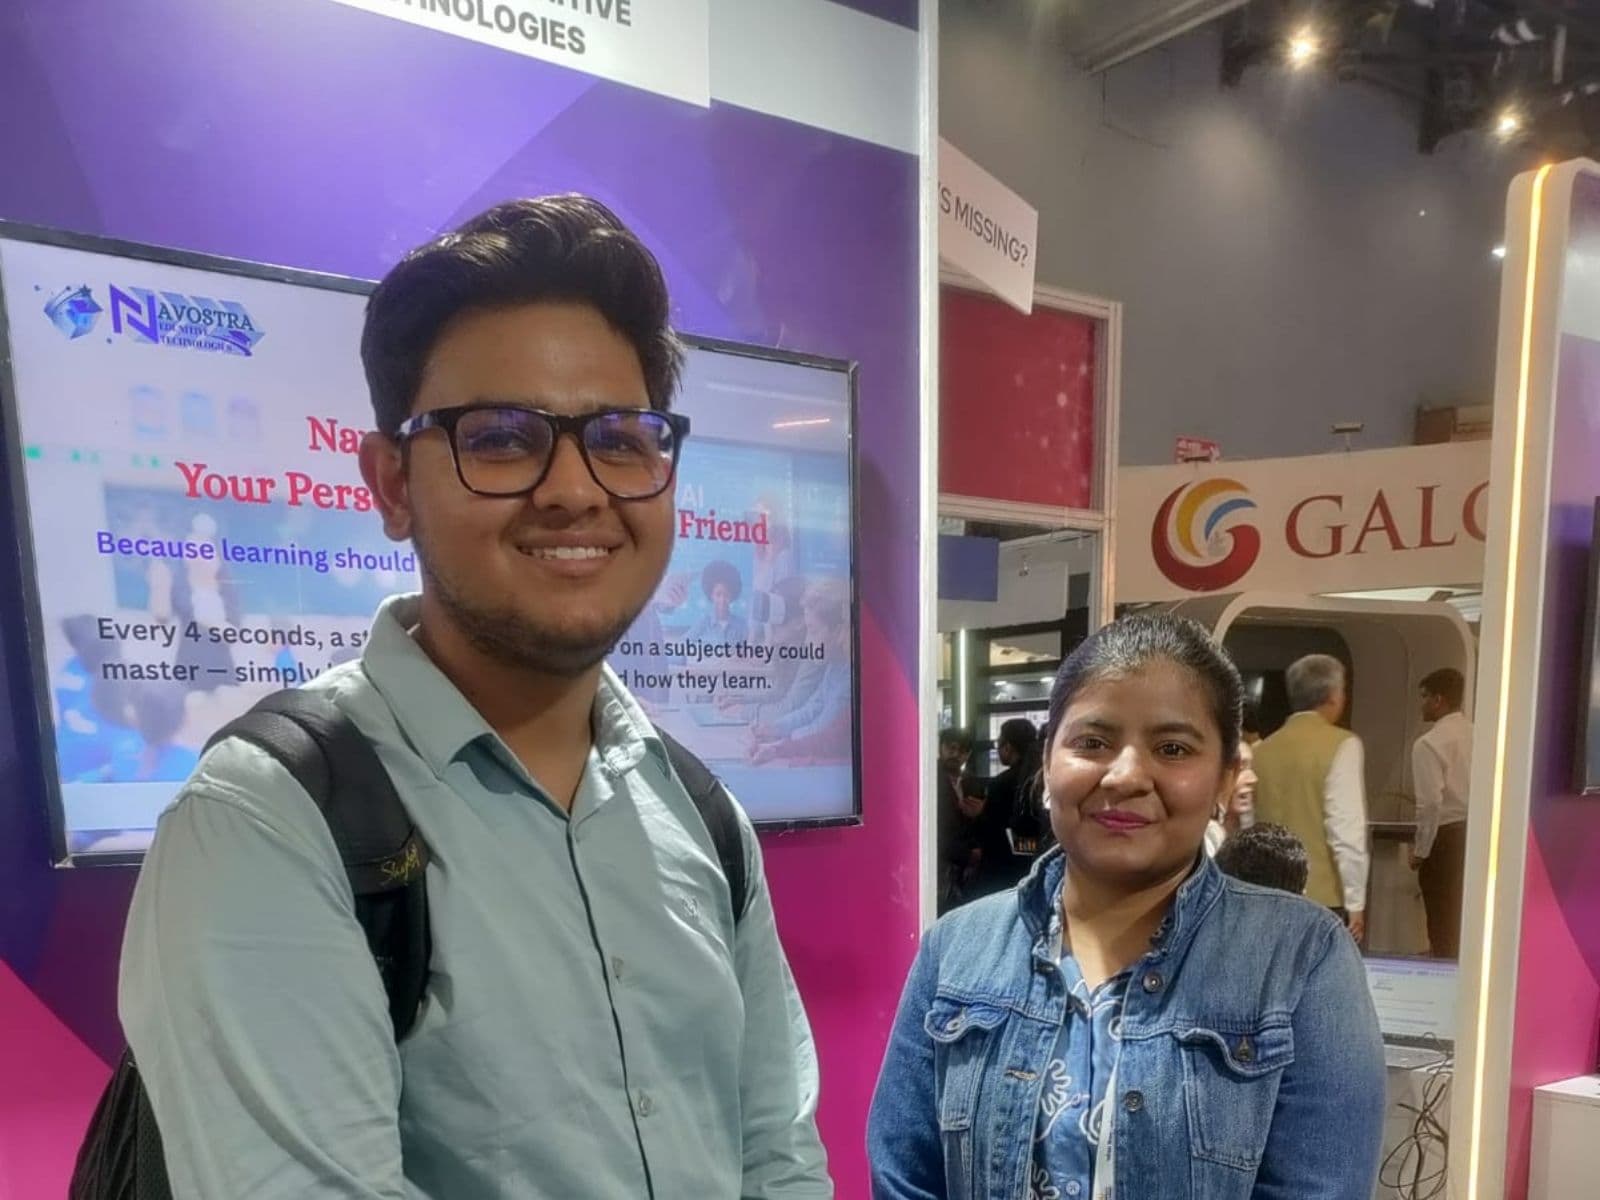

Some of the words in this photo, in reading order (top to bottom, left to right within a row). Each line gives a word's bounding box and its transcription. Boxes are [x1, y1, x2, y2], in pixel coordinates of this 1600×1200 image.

[954, 196, 1029, 268] MISSING?
[306, 416, 365, 454] Na
[175, 462, 275, 504] Your
[285, 471, 373, 512] Pers
[678, 508, 770, 545] Friend
[96, 531, 215, 560] Because
[221, 538, 330, 573] learning
[334, 546, 416, 573] should
[98, 617, 176, 647] Every
[184, 622, 203, 642] 4
[208, 624, 324, 652] seconds,
[330, 630, 345, 647] a
[619, 640, 644, 656] on
[649, 642, 660, 656] a
[663, 638, 732, 663] subject
[735, 640, 774, 665] they
[778, 642, 825, 660] could
[101, 660, 201, 682] master
[633, 669, 673, 689] how
[677, 669, 717, 693] they
[722, 671, 772, 690] learn.
